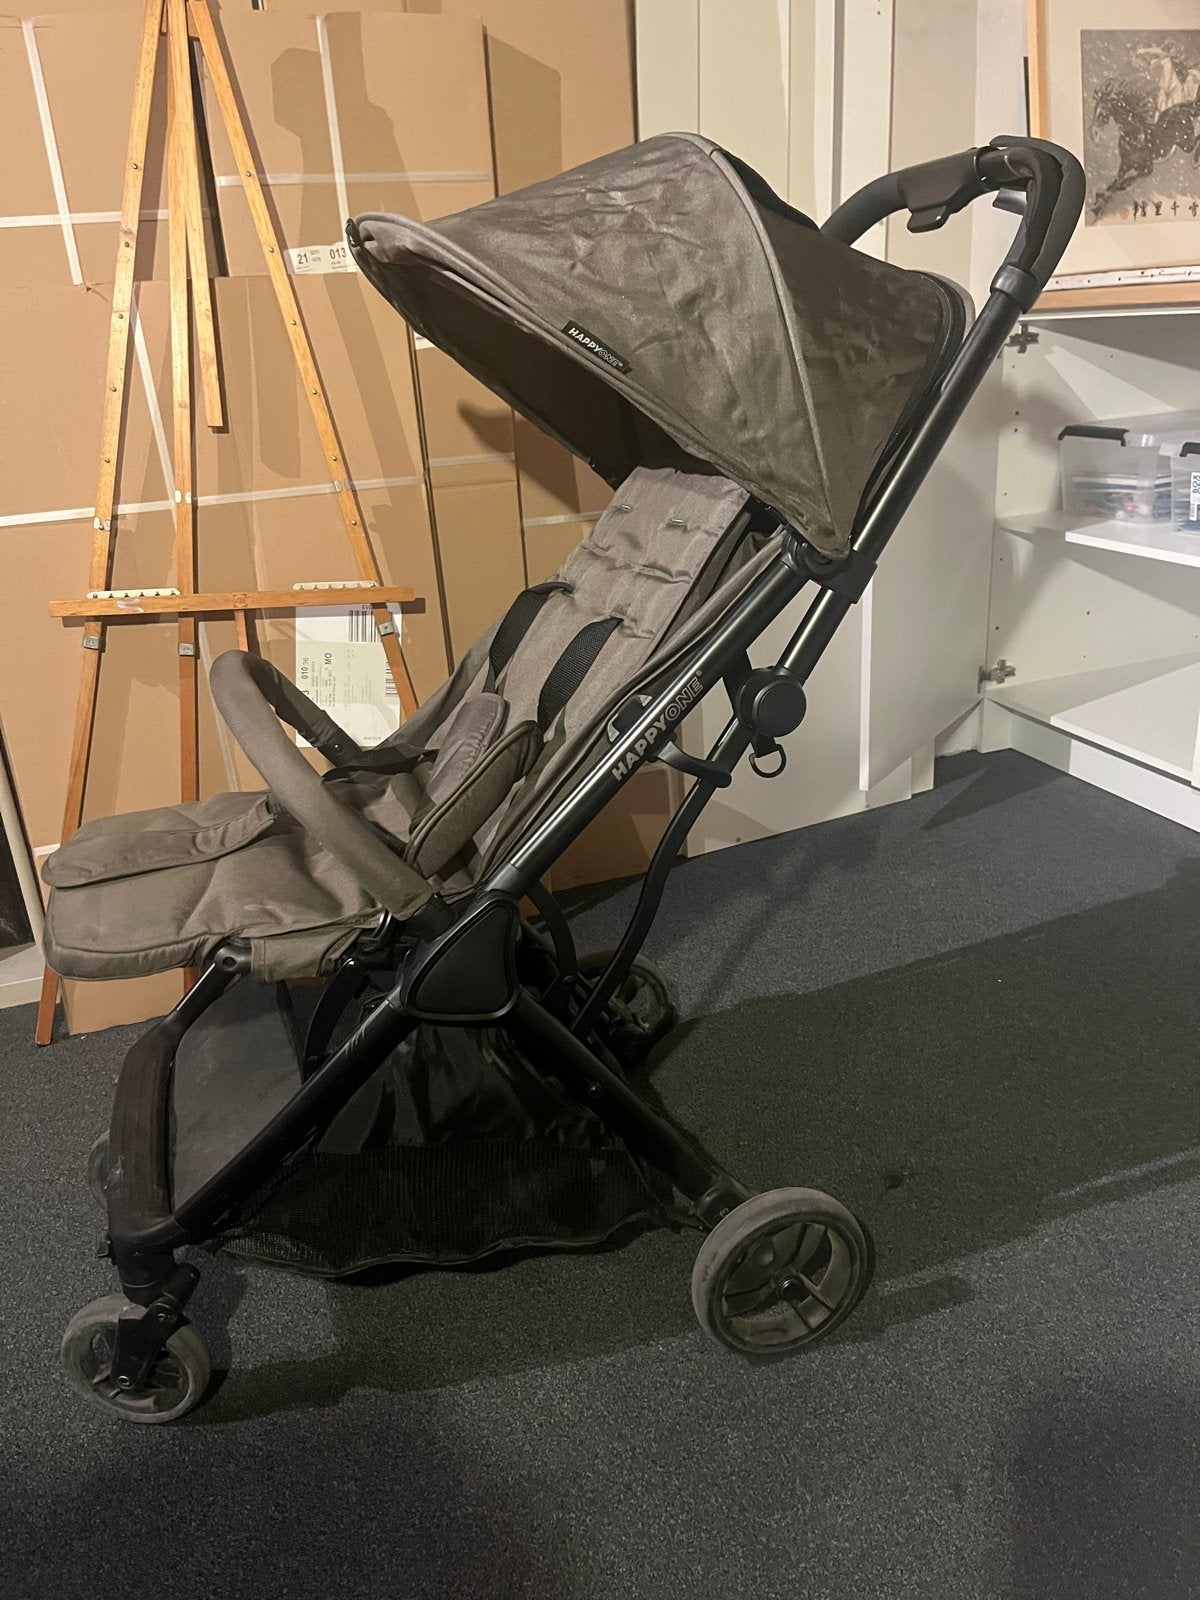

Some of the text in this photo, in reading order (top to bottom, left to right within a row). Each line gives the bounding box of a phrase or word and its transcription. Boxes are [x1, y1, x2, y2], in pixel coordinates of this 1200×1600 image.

[297, 253, 309, 264] 21
[329, 247, 346, 259] 013
[568, 327, 620, 367] HAPPYONE
[302, 657, 309, 666] 36
[324, 652, 332, 665] MO
[301, 666, 309, 680] 010
[612, 676, 703, 781] HAPPYONE
